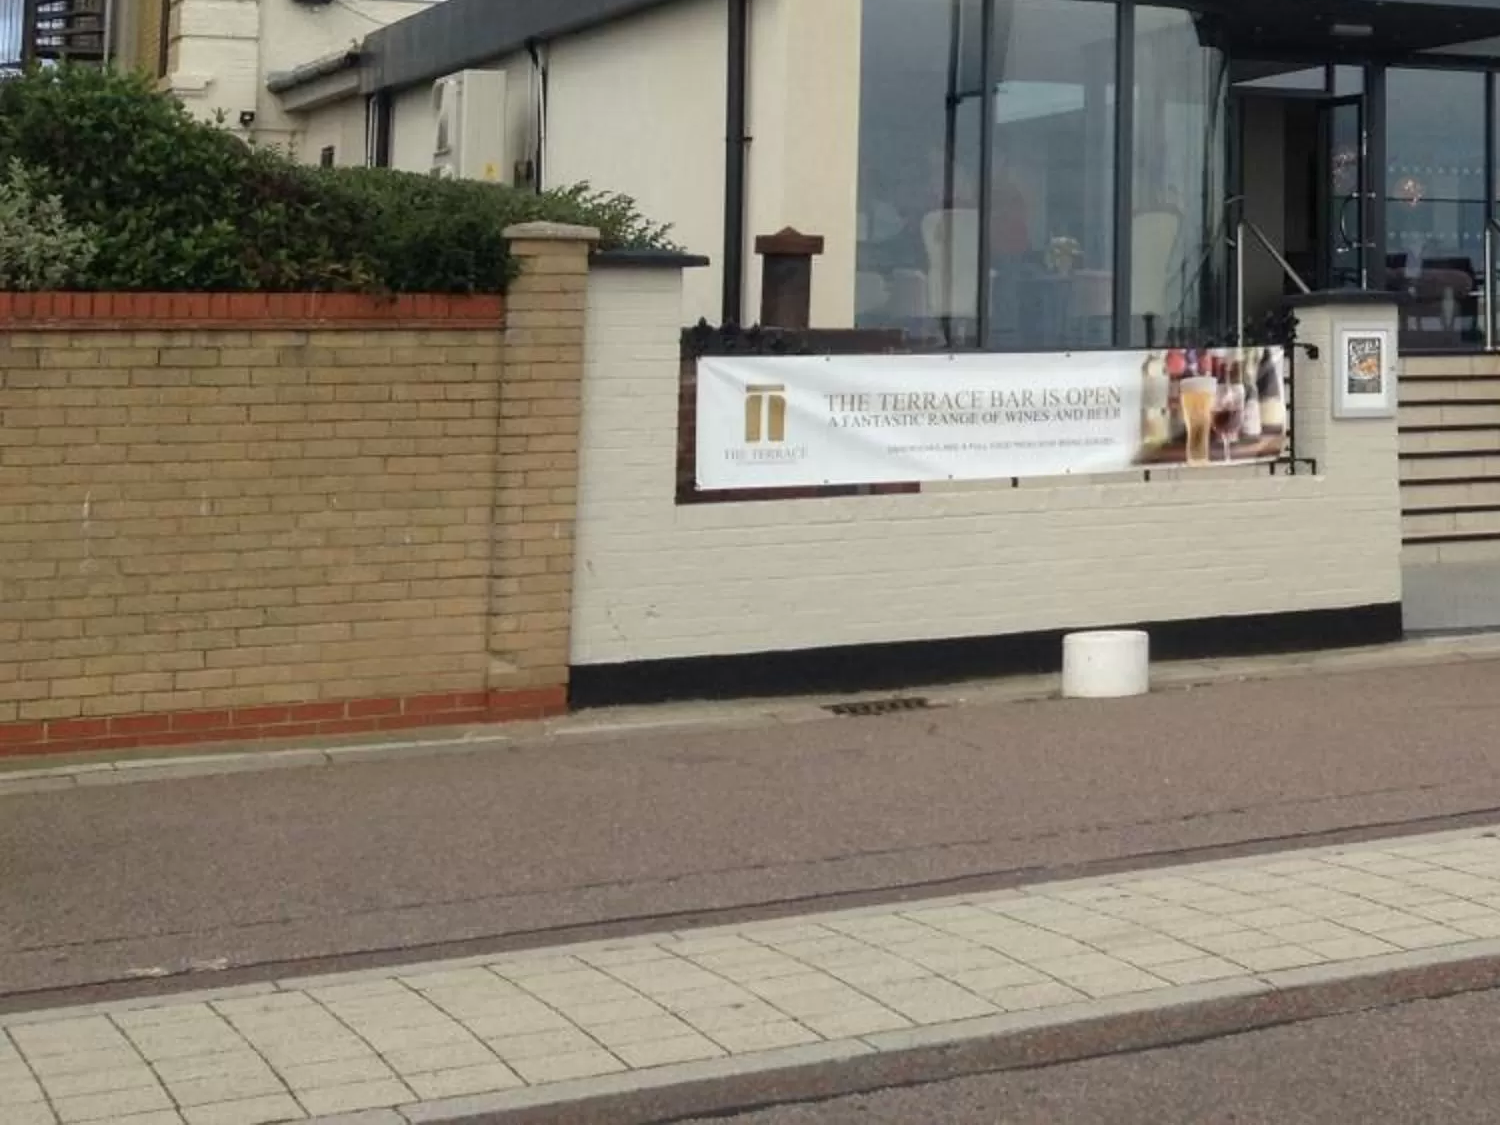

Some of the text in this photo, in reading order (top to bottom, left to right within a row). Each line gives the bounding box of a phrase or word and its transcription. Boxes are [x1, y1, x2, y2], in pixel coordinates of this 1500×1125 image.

[824, 386, 1122, 412] THE TERRACE BAR IS OPEN
[840, 414, 926, 428] FANTASTIC
[928, 412, 978, 426] RANGE
[982, 411, 1001, 425] OF
[1005, 409, 1049, 424] WINES
[1051, 408, 1083, 422] AND
